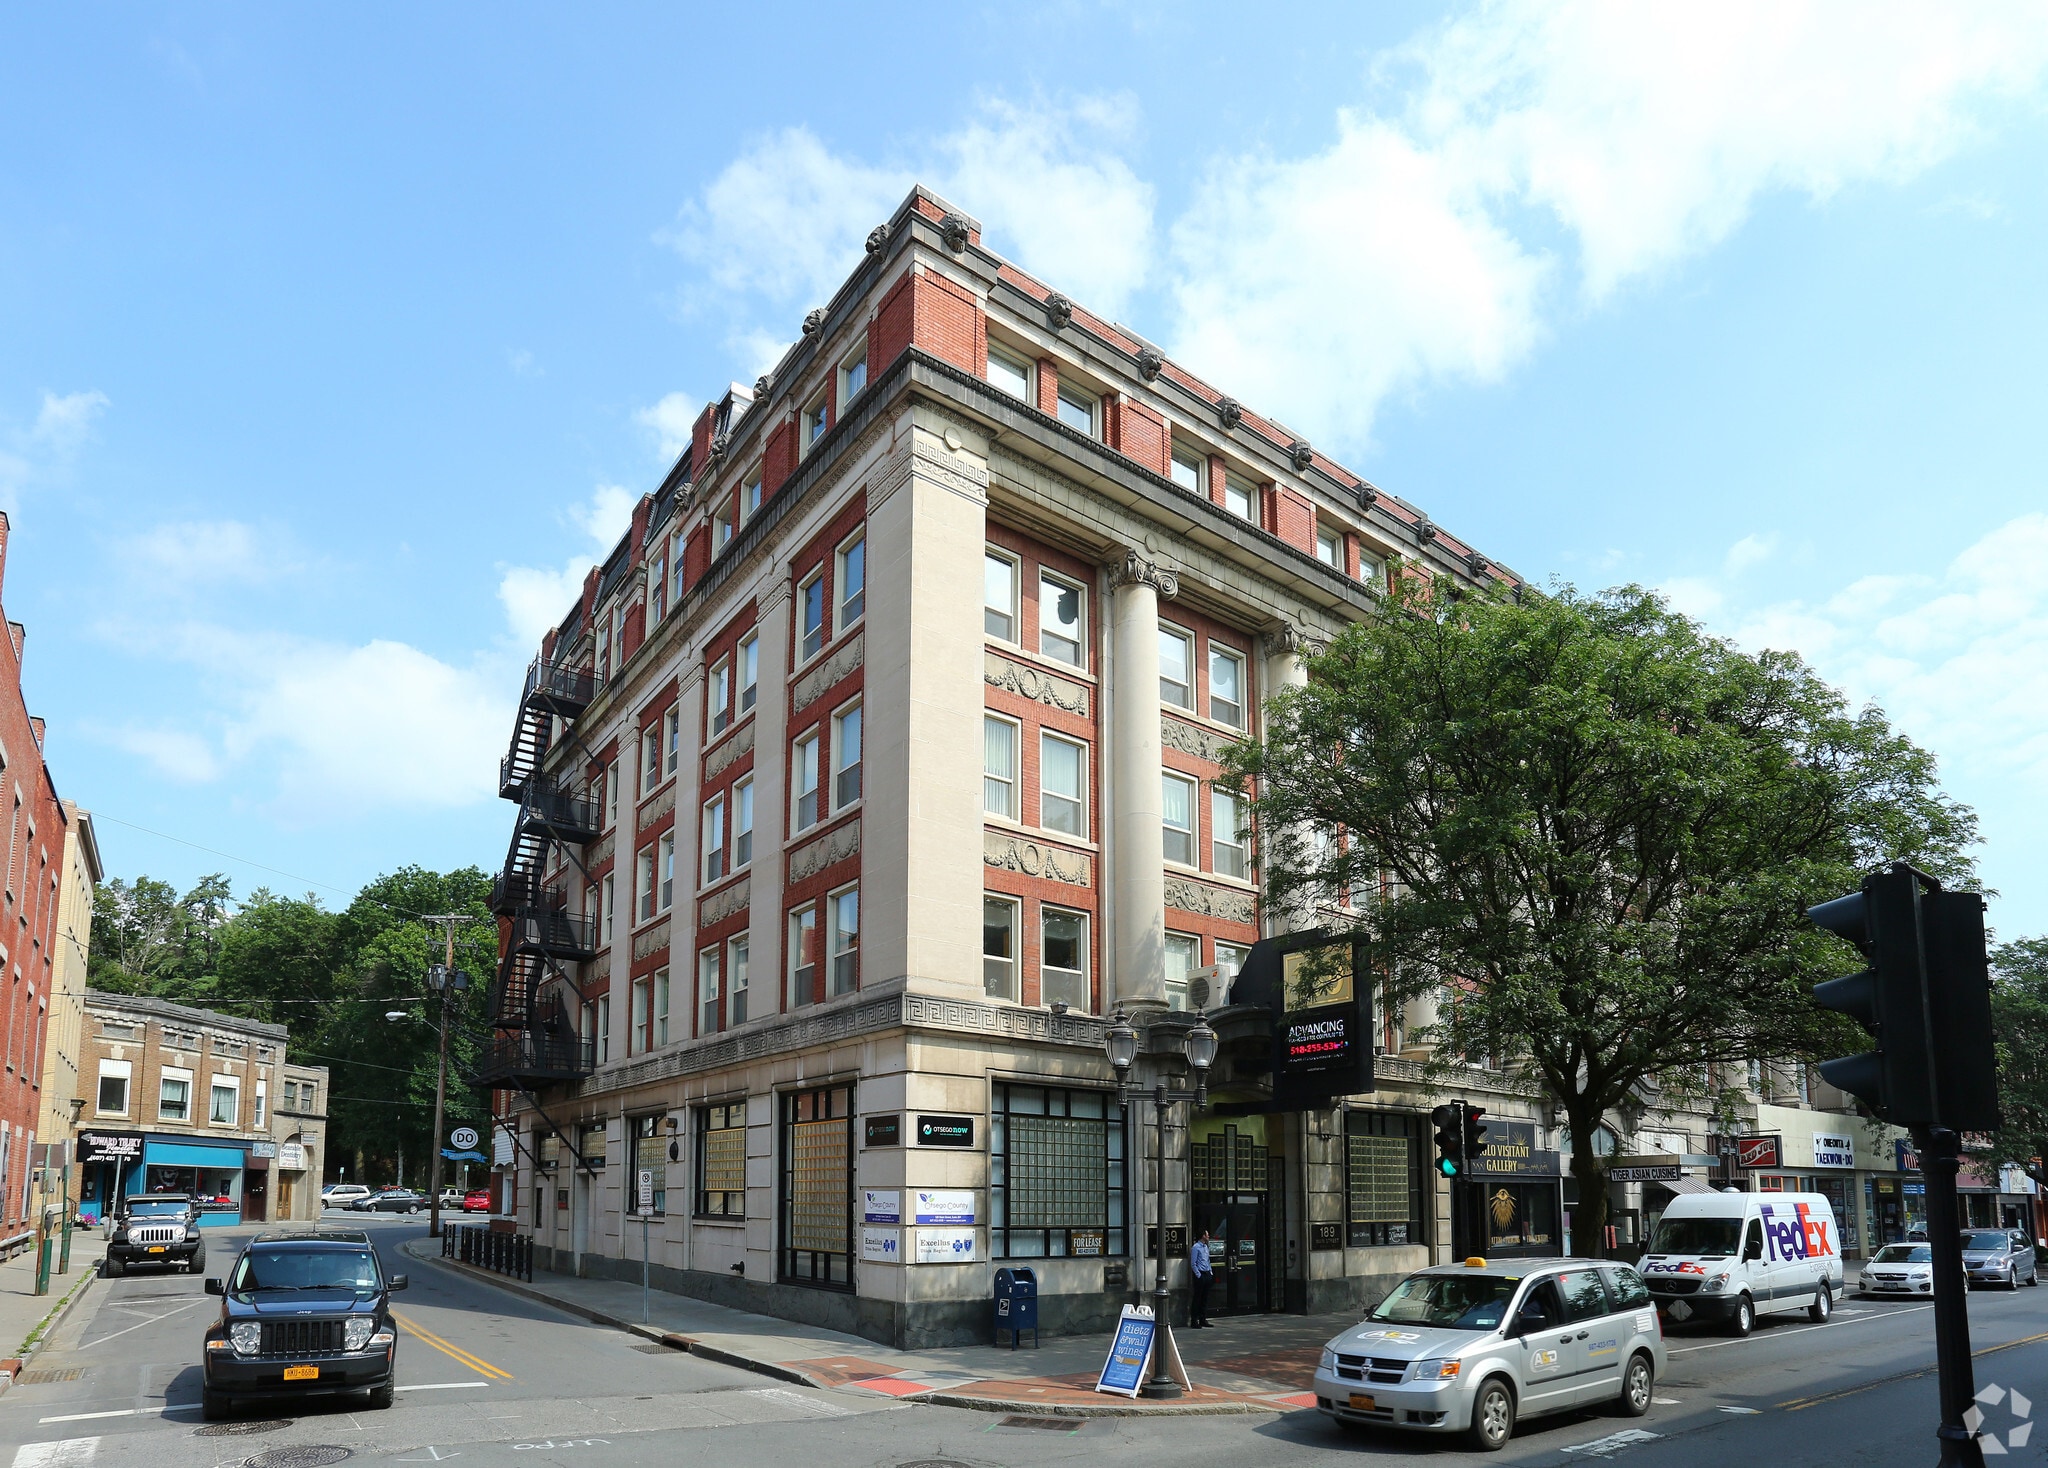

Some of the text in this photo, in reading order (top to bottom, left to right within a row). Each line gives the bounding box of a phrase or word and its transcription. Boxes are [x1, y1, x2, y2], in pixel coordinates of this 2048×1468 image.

[1289, 1019, 1344, 1037] ADVANCING
[456, 1133, 474, 1143] DO
[1497, 1145, 1530, 1158] VISITANT
[1741, 1140, 1775, 1164] RED JUG
[1486, 1159, 1518, 1172] GALLERY
[1612, 1167, 1677, 1180] TIGER ASIAN CUISINE
[1320, 1226, 1335, 1238] 189
[1760, 1203, 1834, 1262] FedEx
[920, 1239, 950, 1247] Excellus
[1073, 1237, 1103, 1248] FOR LEASE
[1643, 1261, 1708, 1275] FedEx
[1123, 1323, 1150, 1336] dietz
[1117, 1346, 1144, 1357] wines
